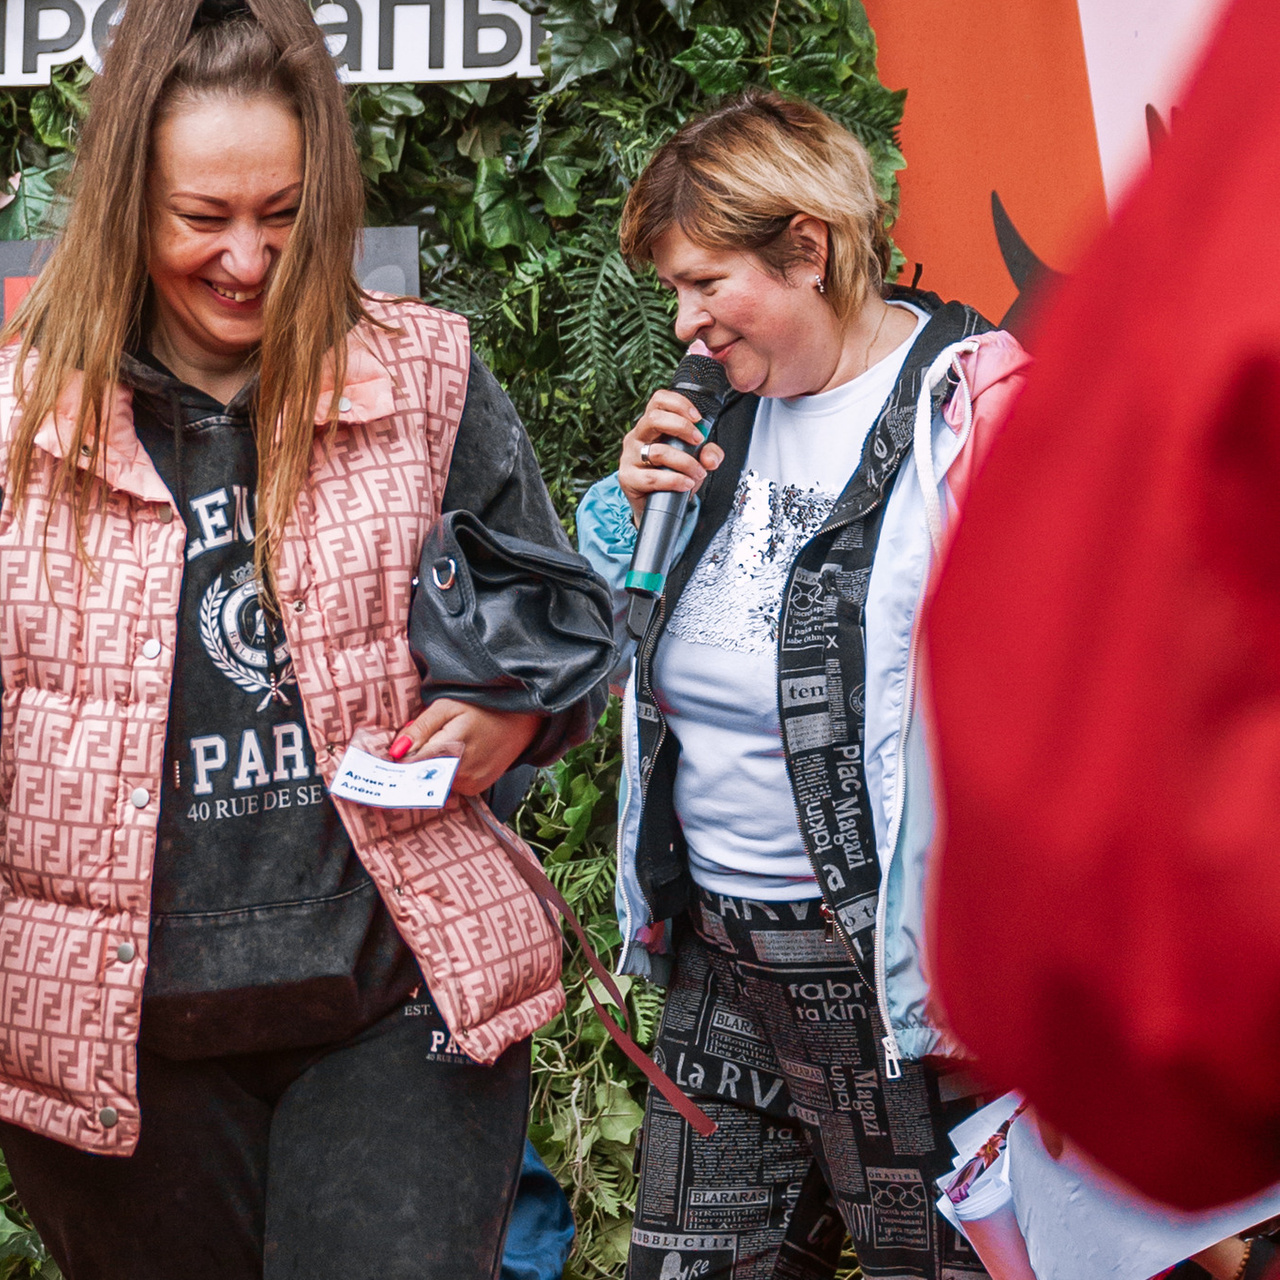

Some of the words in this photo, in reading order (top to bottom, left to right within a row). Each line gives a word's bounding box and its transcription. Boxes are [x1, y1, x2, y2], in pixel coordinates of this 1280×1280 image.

[190, 721, 322, 795] PAR
[187, 801, 210, 822] 40
[215, 795, 258, 819] RUE
[263, 788, 291, 810] DE
[404, 1004, 433, 1016] EST.
[430, 1030, 470, 1053] PA
[693, 1191, 766, 1204] BLARARAS
